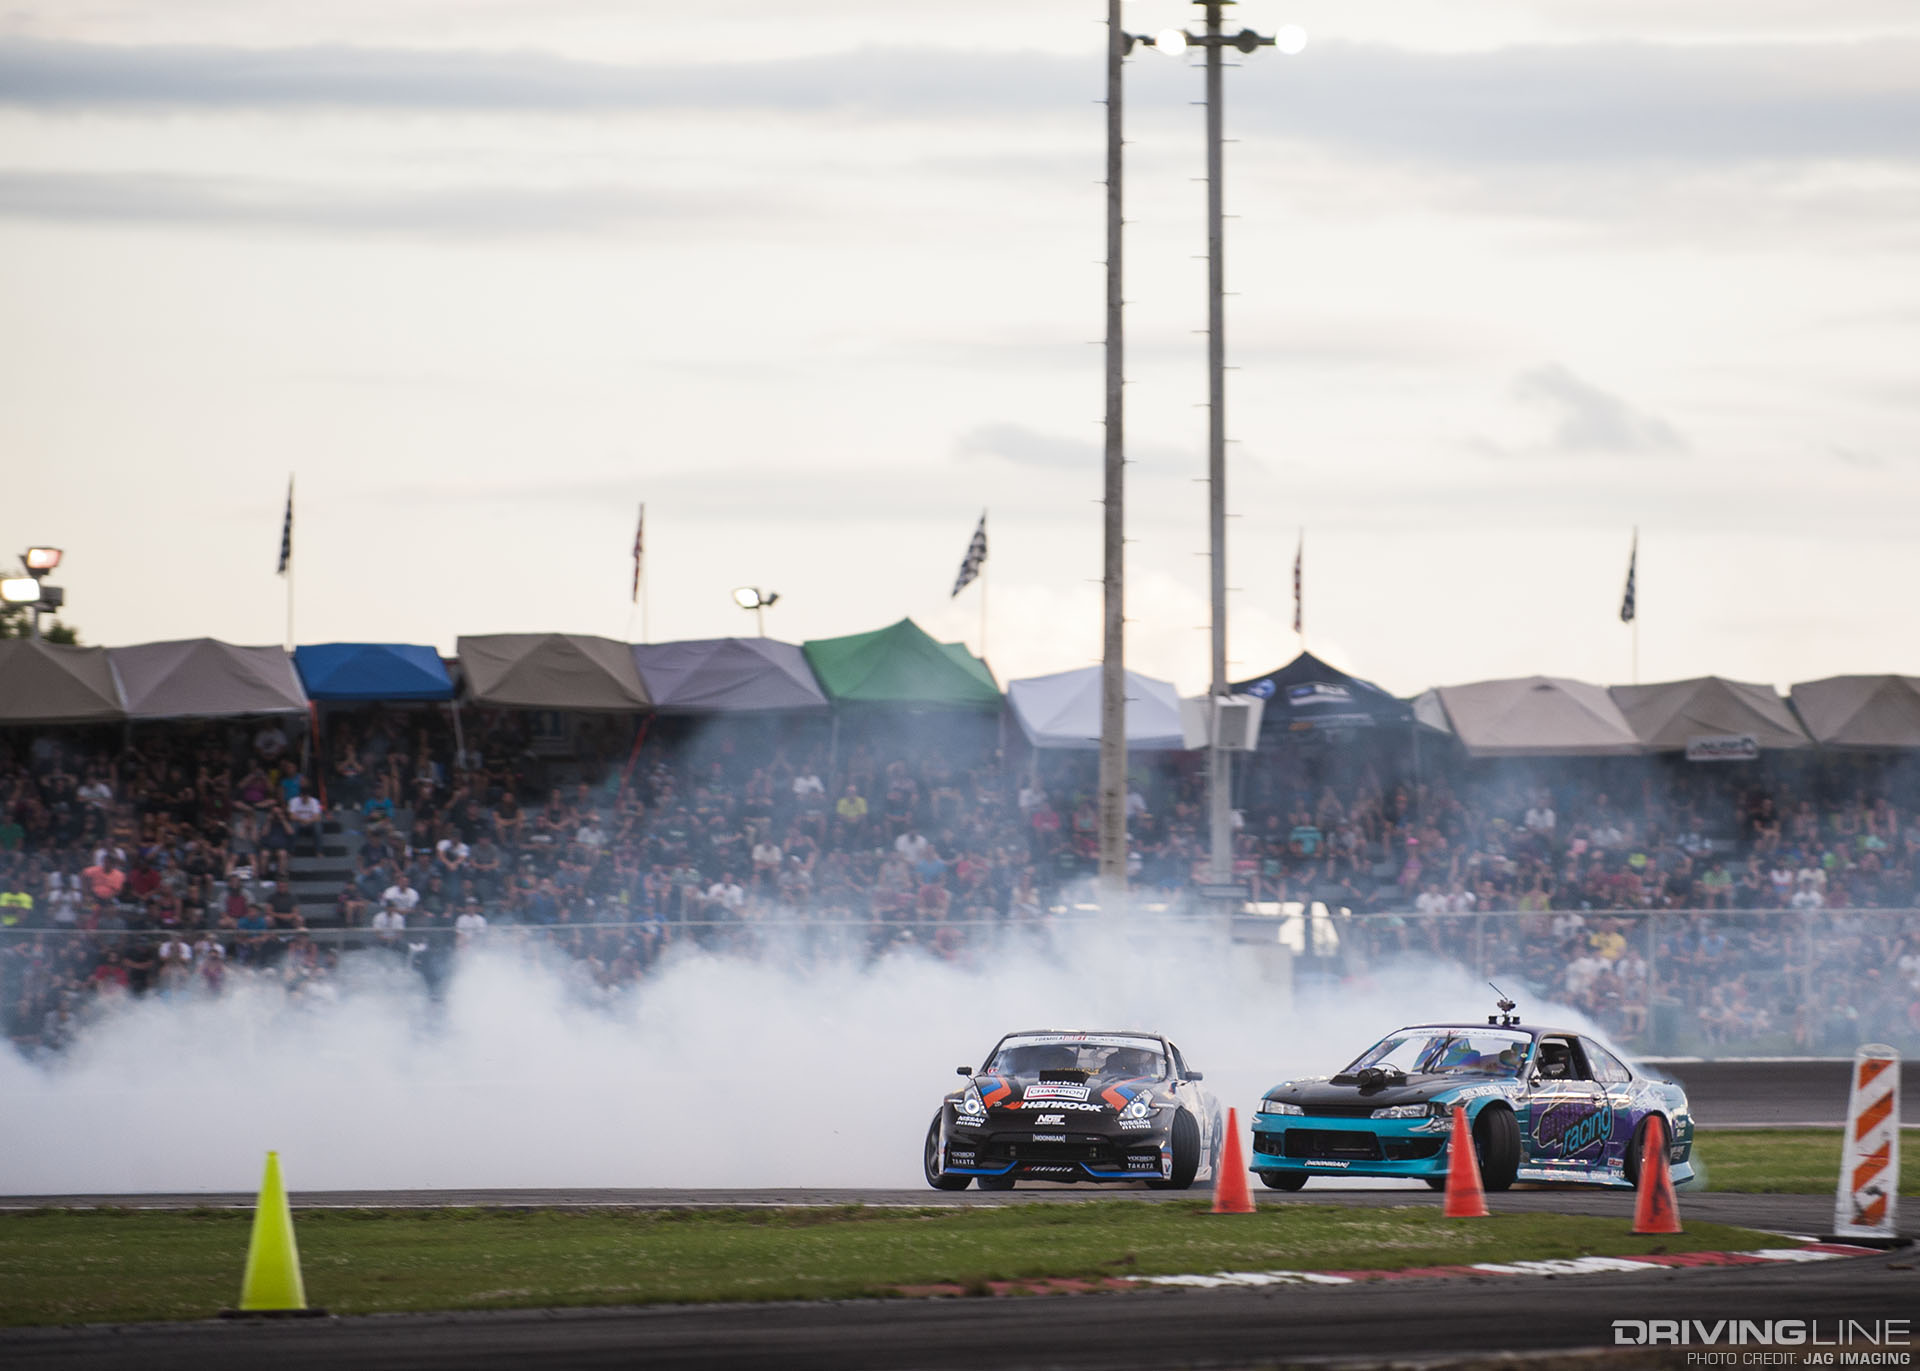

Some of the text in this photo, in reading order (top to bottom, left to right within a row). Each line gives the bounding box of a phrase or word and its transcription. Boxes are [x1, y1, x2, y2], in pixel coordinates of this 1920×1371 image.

[1030, 1088, 1084, 1097] CHAMPION
[1021, 1101, 1104, 1113] HANKOOK
[957, 1115, 986, 1124] NISSAN
[1118, 1118, 1151, 1127] NISSAN
[1562, 1104, 1612, 1156] racing
